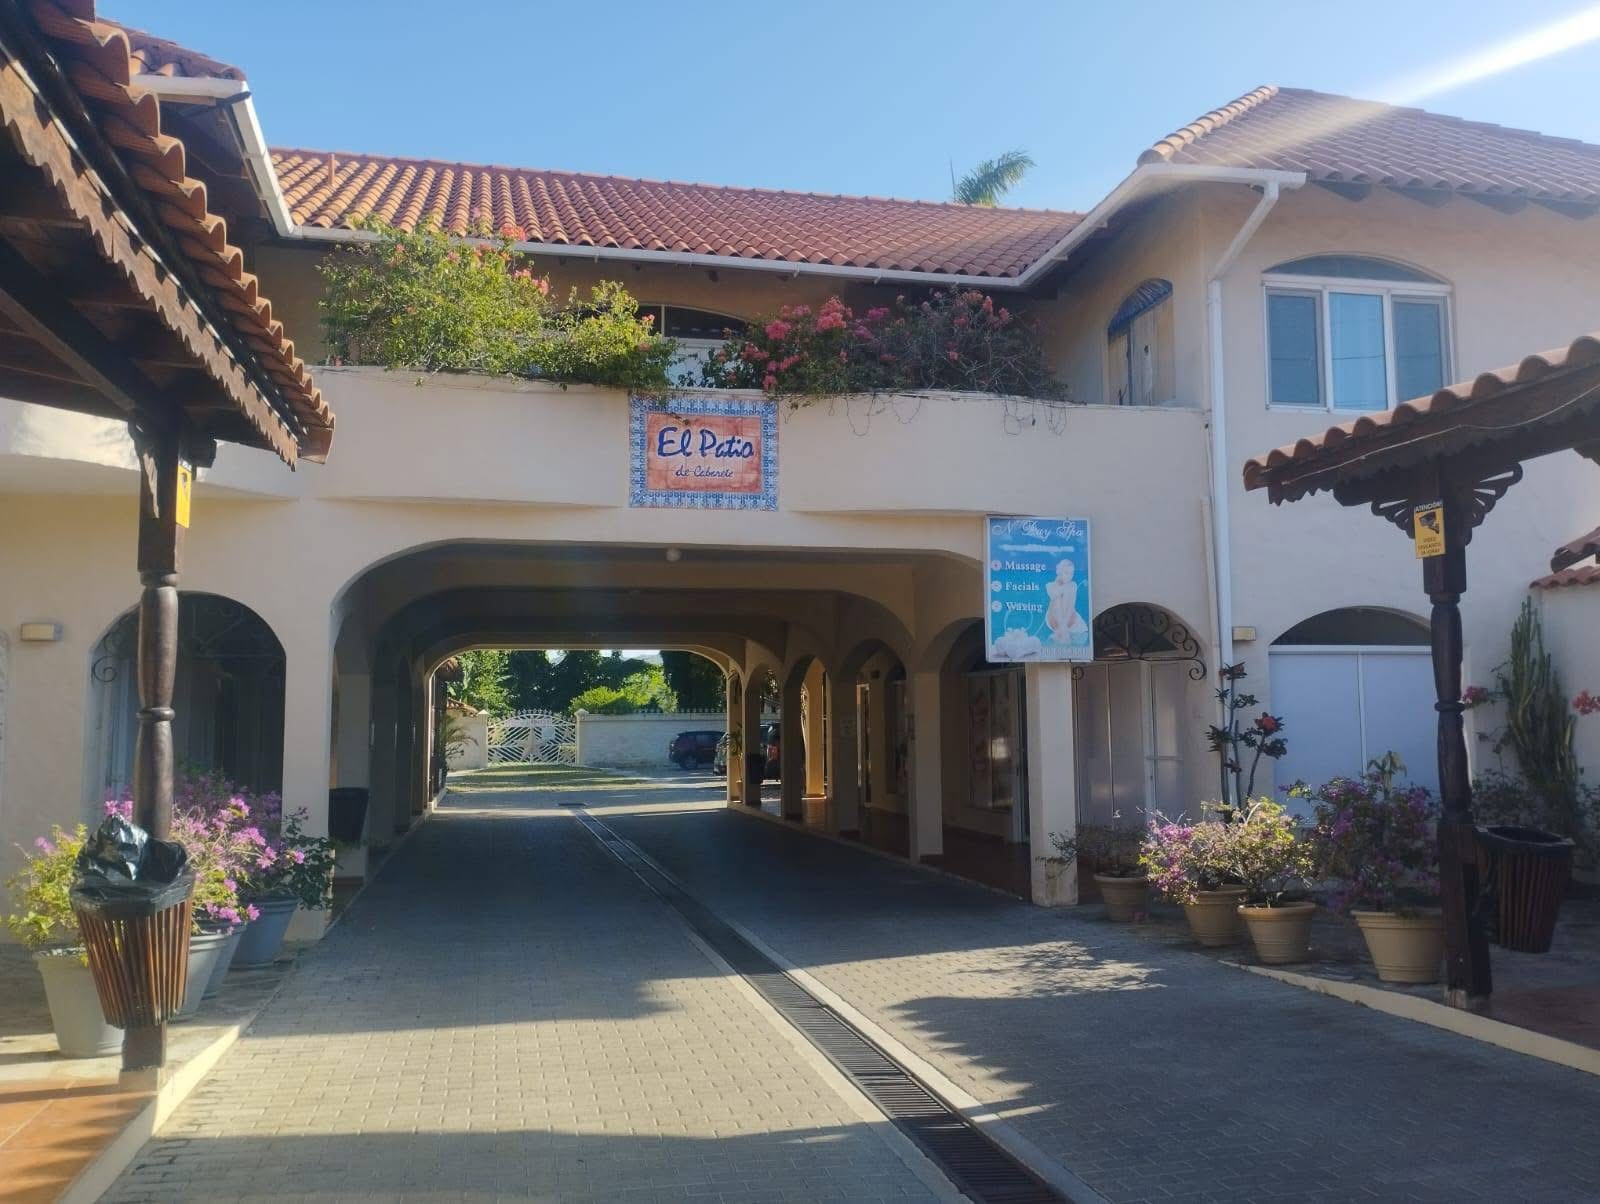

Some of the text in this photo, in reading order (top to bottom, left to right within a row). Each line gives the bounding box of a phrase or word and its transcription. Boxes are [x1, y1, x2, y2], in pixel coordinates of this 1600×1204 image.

[658, 427, 755, 458] El Patio
[675, 465, 690, 477] de
[1004, 560, 1047, 573] Massage
[1005, 582, 1040, 592] Facials
[1005, 601, 1043, 613] Waxing
